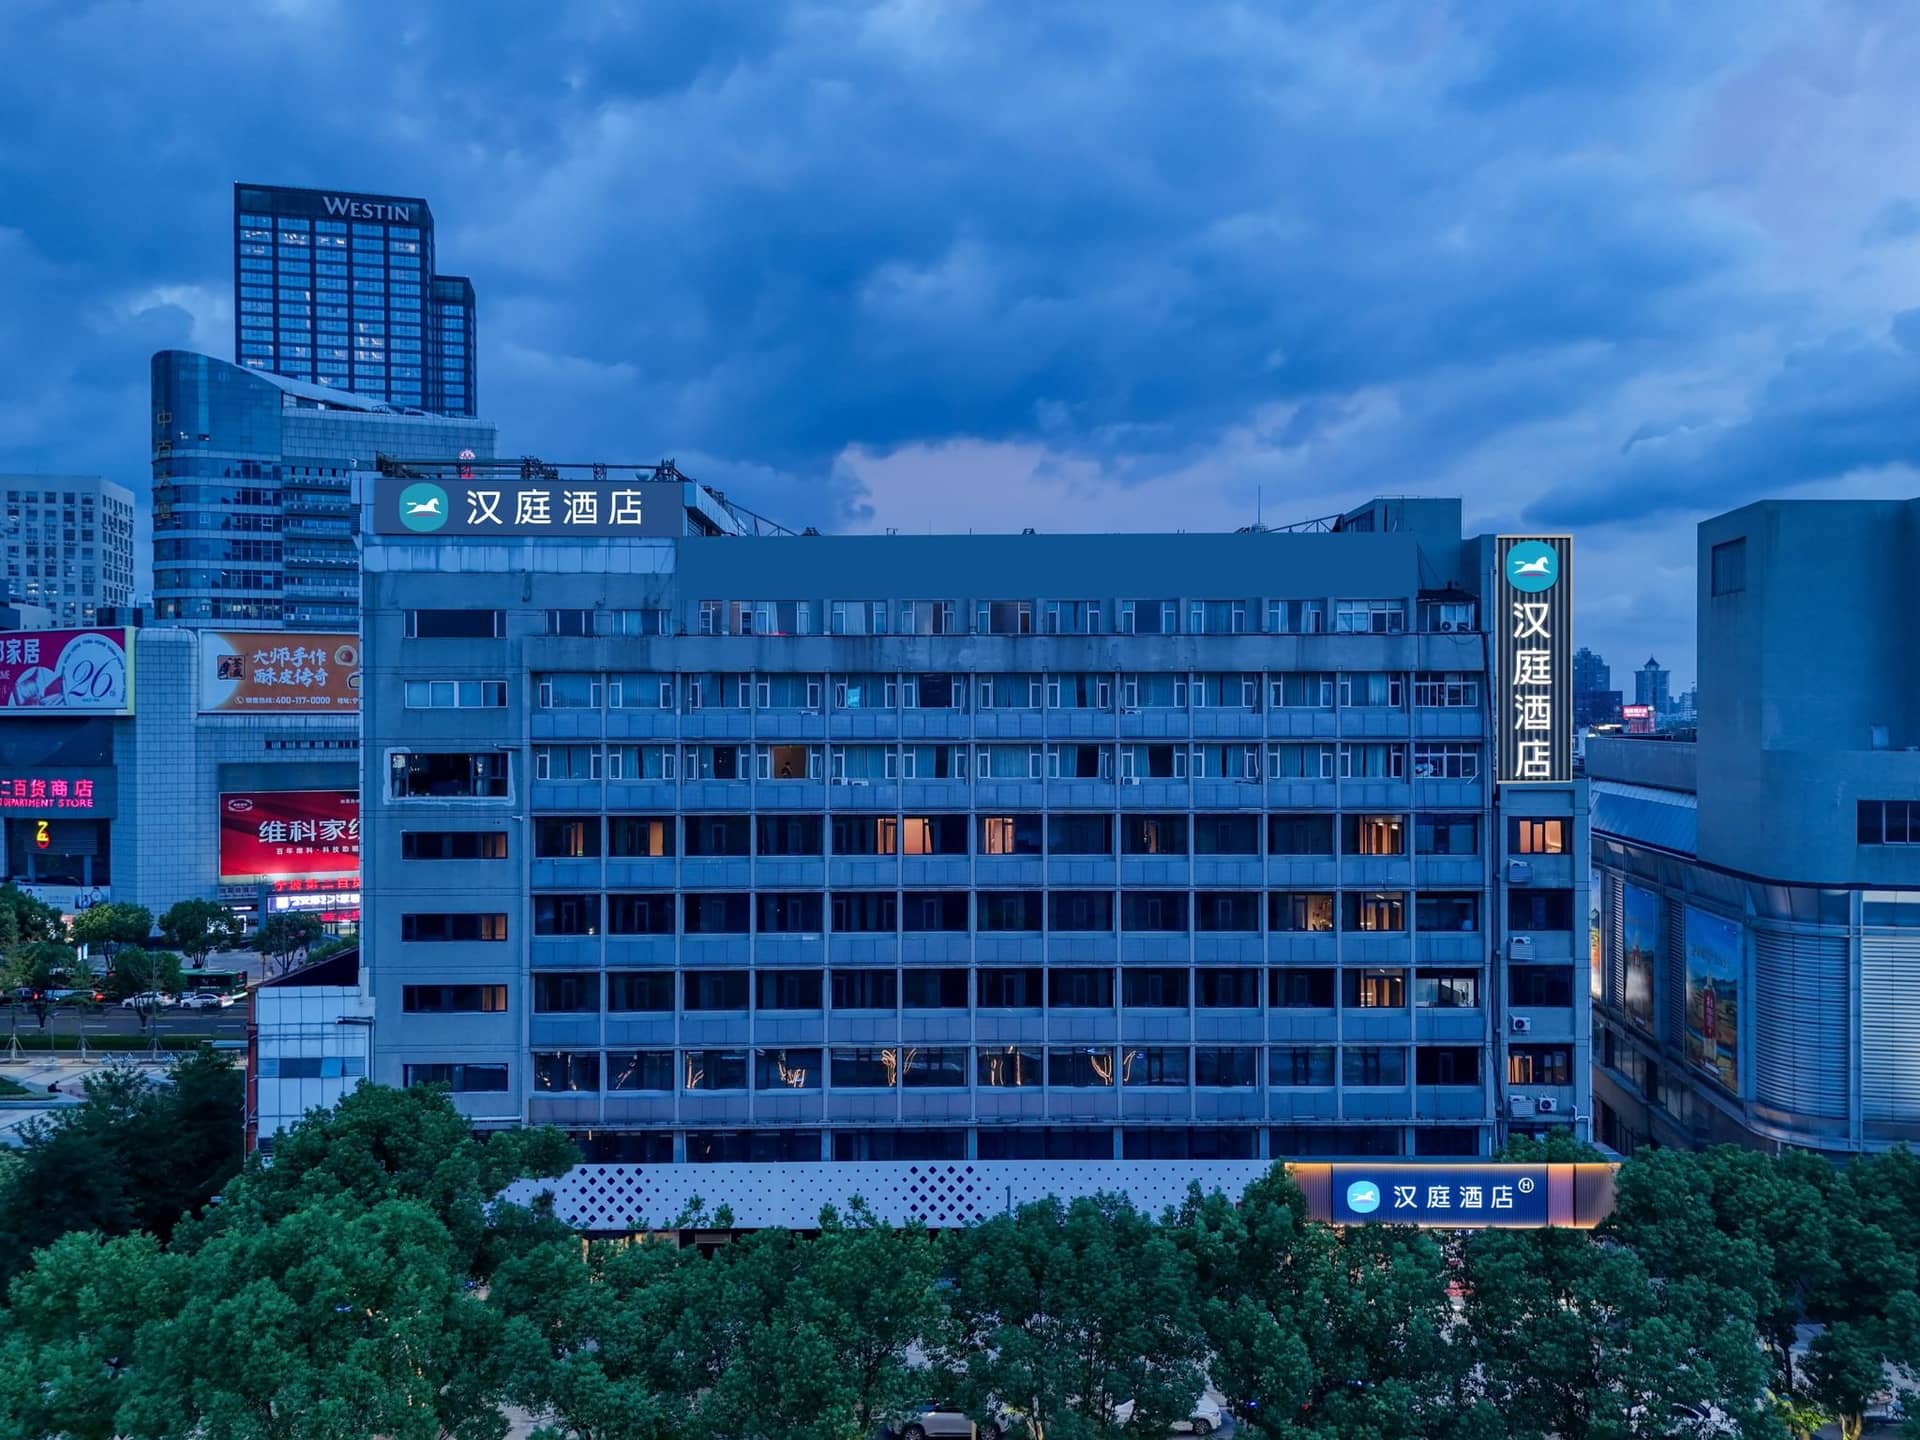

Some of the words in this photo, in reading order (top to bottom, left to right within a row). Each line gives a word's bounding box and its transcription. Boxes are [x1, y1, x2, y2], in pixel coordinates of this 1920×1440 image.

[322, 196, 409, 221] WESTIN
[466, 488, 642, 525] 汉庭酒店
[253, 646, 327, 667] 大师手作
[253, 667, 329, 687] 酥皮传奇
[1512, 601, 1553, 777] 汉庭酒店
[0, 779, 94, 798] 二百货商店
[58, 799, 94, 808] STORE
[1393, 1185, 1513, 1209] 汉庭酒店
